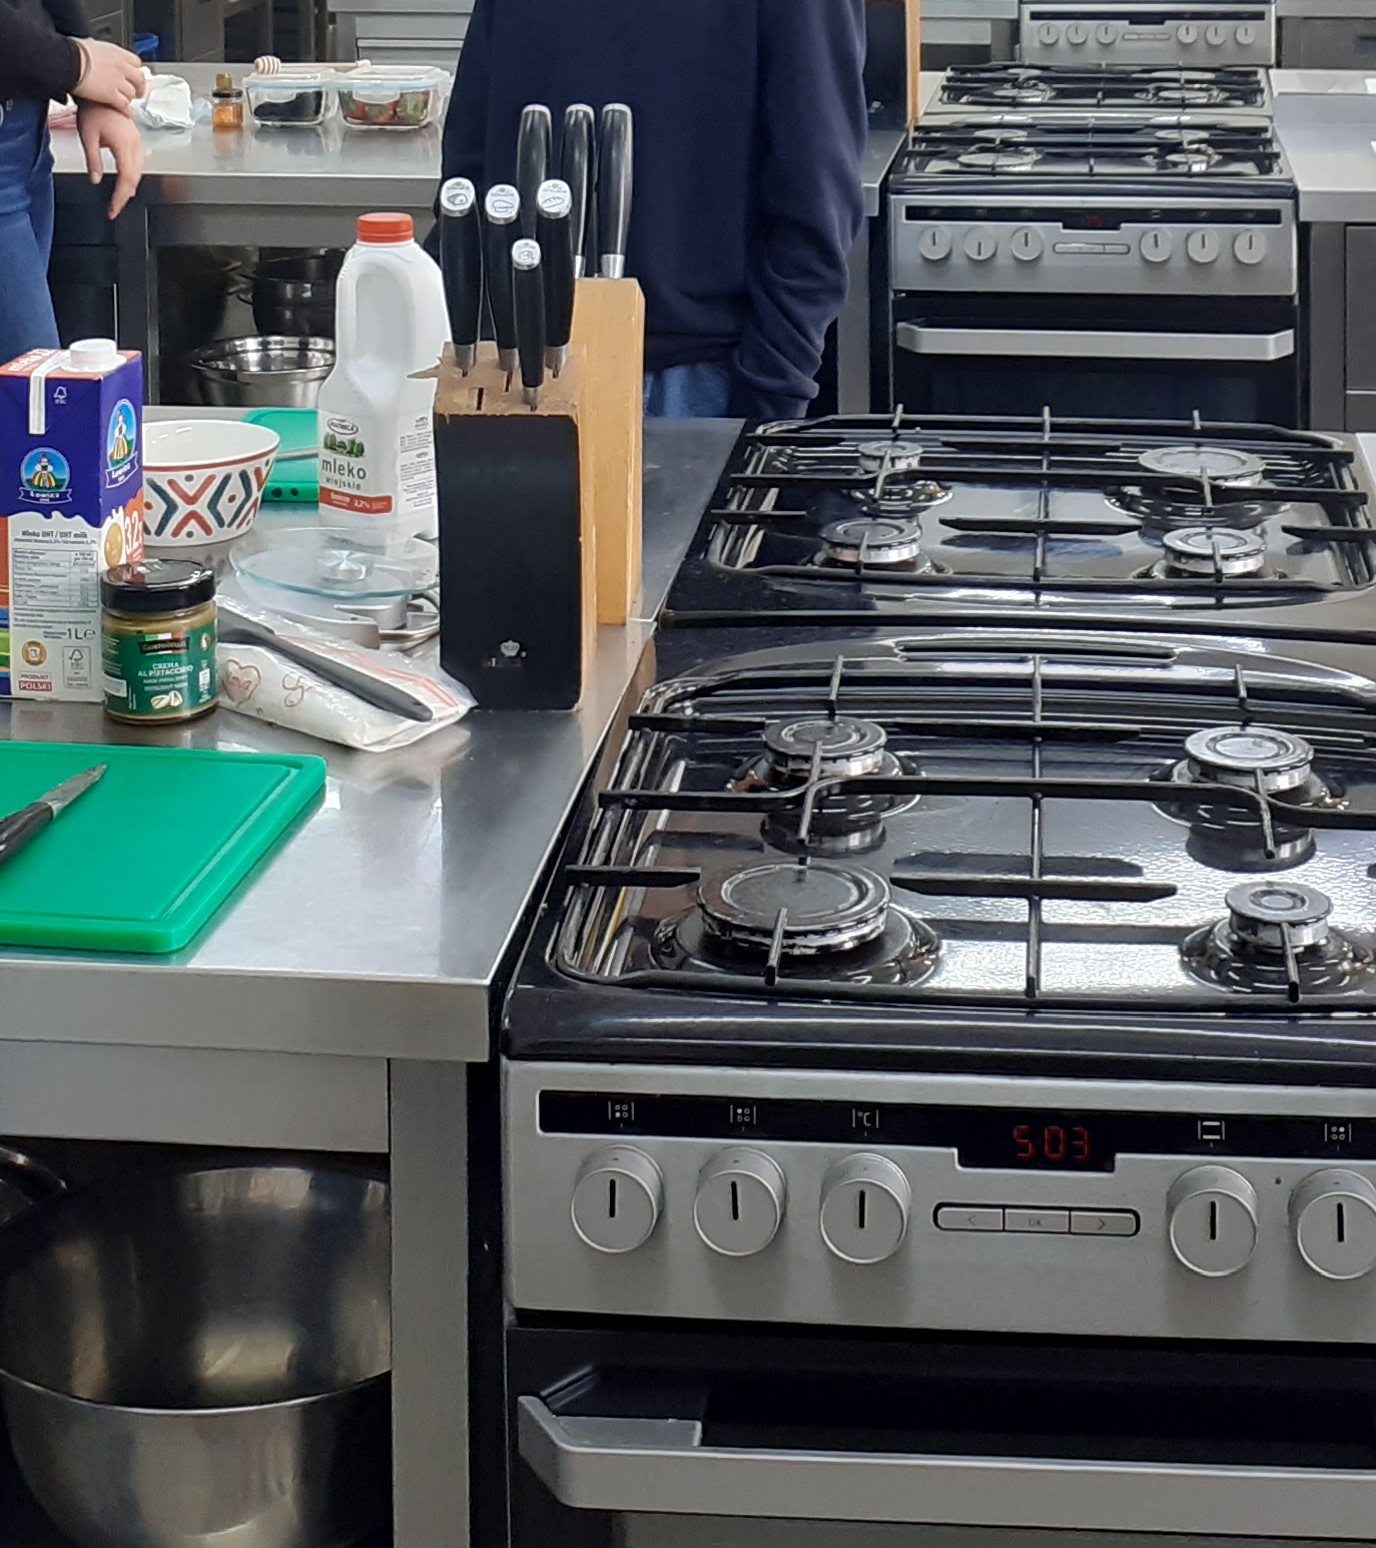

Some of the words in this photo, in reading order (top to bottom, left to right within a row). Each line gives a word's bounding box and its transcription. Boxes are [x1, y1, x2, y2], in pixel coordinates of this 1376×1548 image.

[322, 458, 367, 480] mleko
[325, 477, 362, 491] wiejskie
[20, 682, 52, 690] POLSKI
